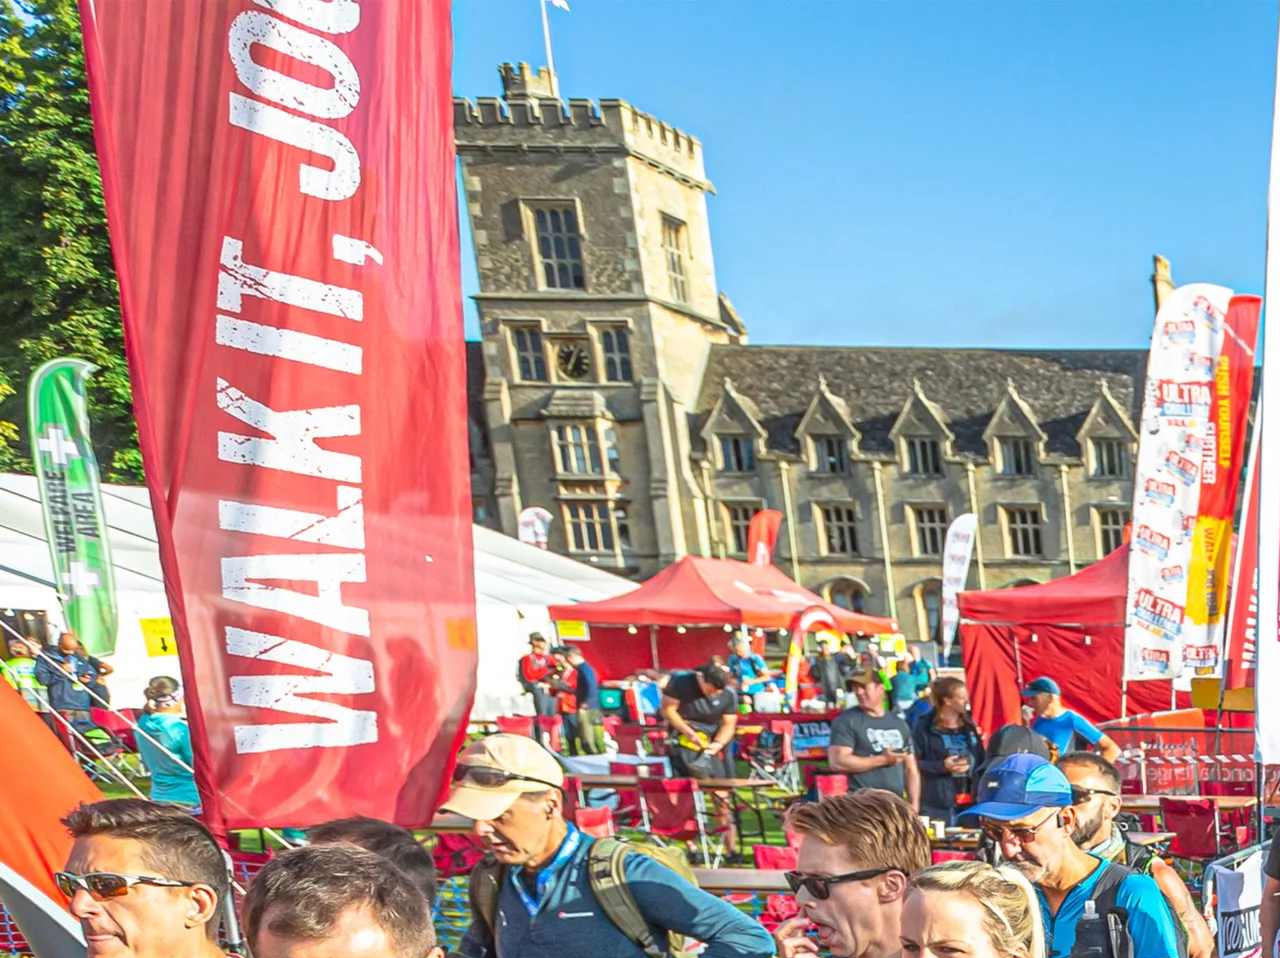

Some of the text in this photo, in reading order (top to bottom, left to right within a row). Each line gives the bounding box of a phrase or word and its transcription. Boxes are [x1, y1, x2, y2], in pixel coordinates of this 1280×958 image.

[215, 0, 384, 754] WALK IT, JO
[1161, 383, 1212, 405] ULTRA
[44, 470, 77, 554] WELFARE
[71, 491, 100, 539] AREA
[1138, 591, 1183, 625] ULTRA
